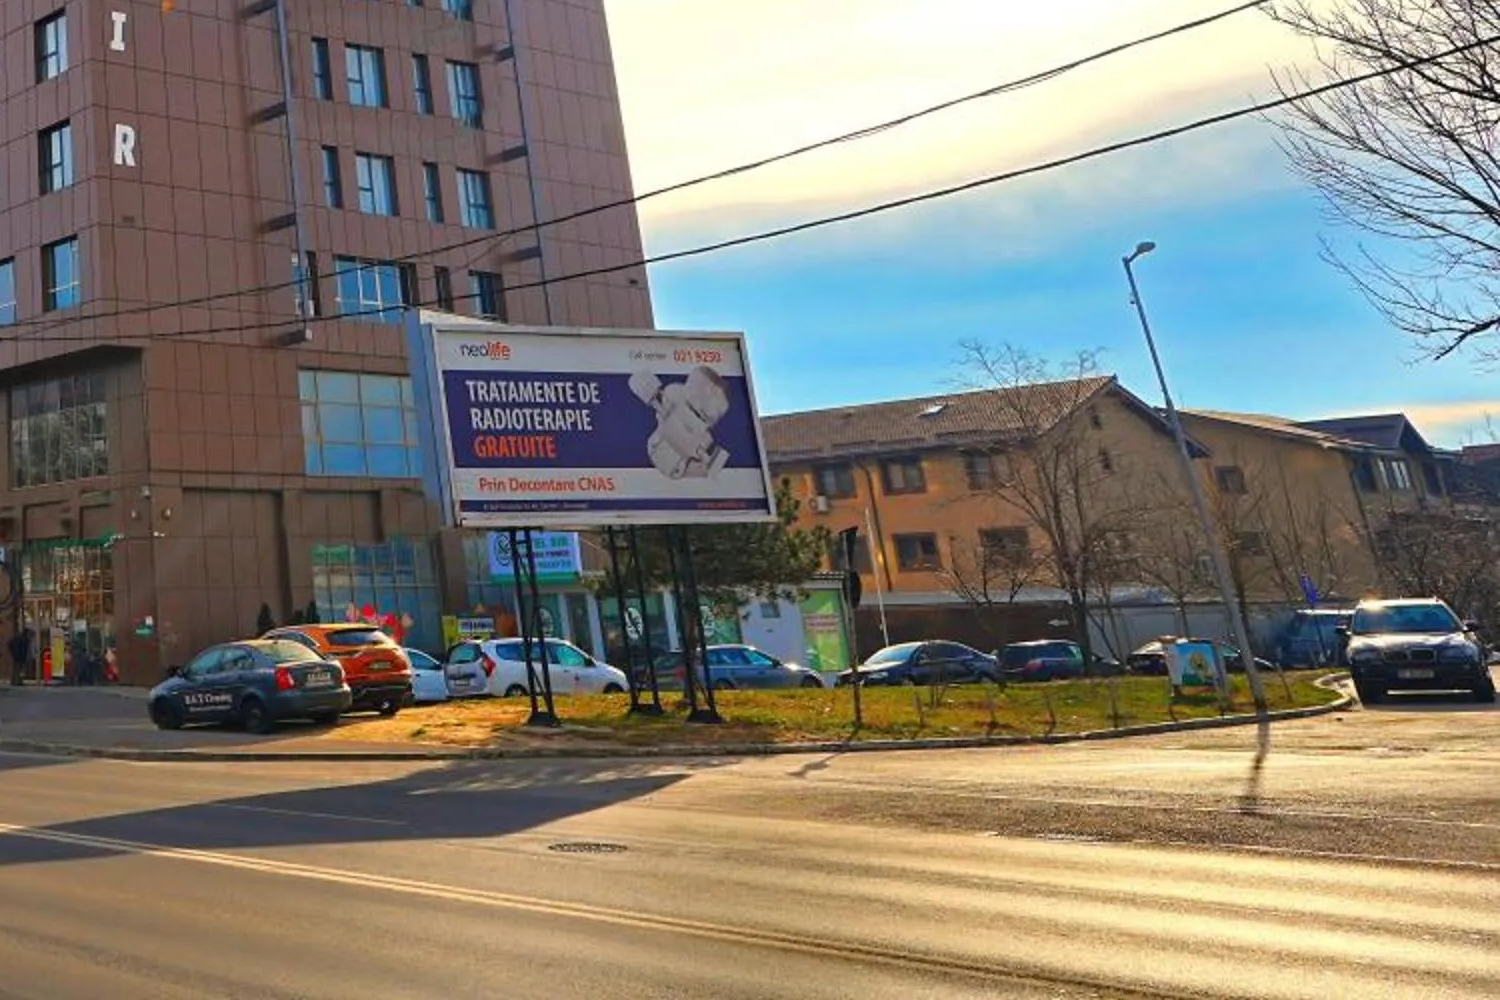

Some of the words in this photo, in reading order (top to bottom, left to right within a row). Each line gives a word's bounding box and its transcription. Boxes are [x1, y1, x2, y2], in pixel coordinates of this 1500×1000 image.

[459, 341, 511, 357] neolife
[465, 380, 576, 403] TRATAMENTE
[577, 382, 601, 404] DE
[470, 408, 592, 431] RADIOTERAPIE
[474, 435, 557, 458] GRATUITE
[479, 477, 505, 492] Prin
[508, 477, 576, 492] Decontare
[578, 475, 616, 492] CNAS
